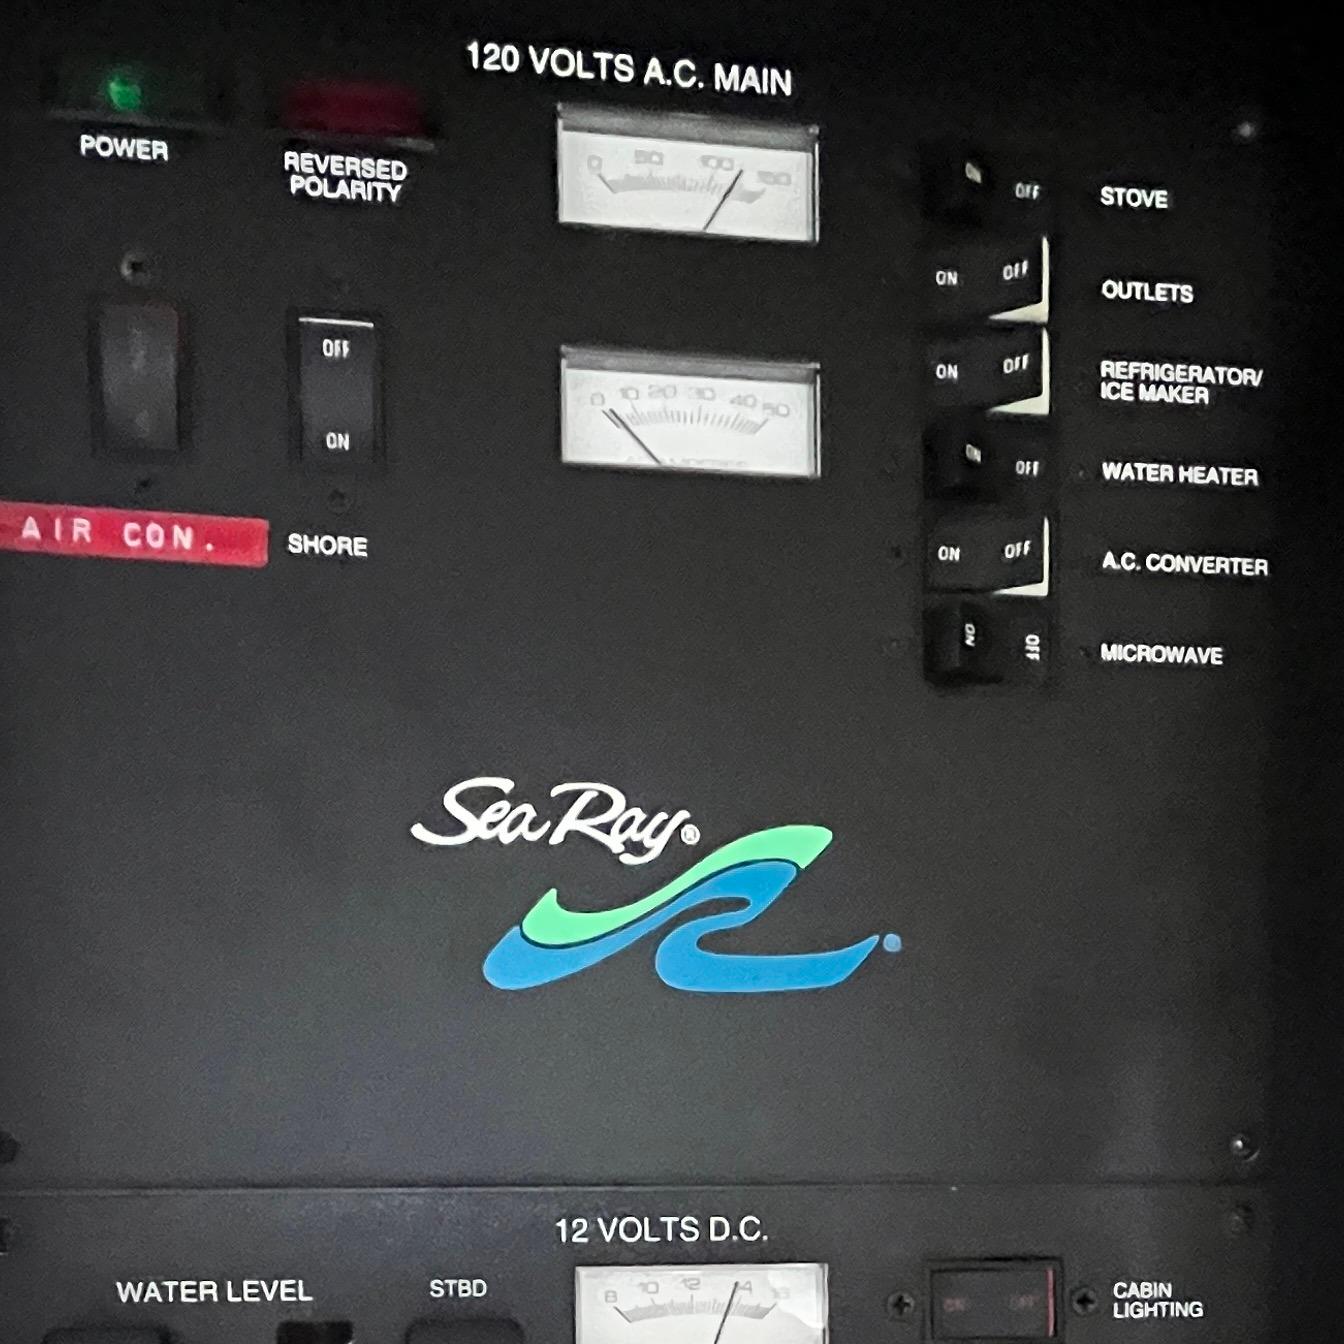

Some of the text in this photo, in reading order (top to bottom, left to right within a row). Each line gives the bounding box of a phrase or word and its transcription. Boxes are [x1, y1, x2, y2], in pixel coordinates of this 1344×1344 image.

[467, 41, 791, 96] 120 VOLTS A.C. MAIN
[81, 135, 168, 161] POWER
[284, 151, 407, 183] REVERSED
[290, 172, 404, 202] POLARITY
[1016, 183, 1039, 199] OFF
[1101, 186, 1168, 208] STOVE
[936, 260, 1028, 285] ON OFF
[1102, 280, 1193, 303] OUTLETS
[323, 339, 349, 357] OFF
[936, 354, 1028, 379] ON OFF
[1101, 360, 1263, 390] REFRIGERATOR/
[1101, 382, 1209, 404] ICE MAKER
[326, 432, 349, 450] ON
[1016, 461, 1039, 476] OFF
[1102, 462, 1258, 486] WATER HEATER
[22, 517, 213, 551] AIR CON.
[288, 533, 367, 557] SHORE
[938, 540, 1030, 561] ON OFF
[1103, 551, 1268, 576] A.C. CONVERTER
[965, 624, 1040, 660] ON OFF
[1101, 643, 1223, 665] MICROWAVE
[410, 776, 552, 846] Sea
[556, 1216, 767, 1243] 12 VOLTS D.C.
[116, 1280, 313, 1302] WATER LEVEL
[430, 1279, 487, 1297] STBD
[639, 1278, 700, 1294] 10 12
[1113, 1282, 1172, 1298] CABIN
[1114, 1301, 1203, 1318] LIGHTING
